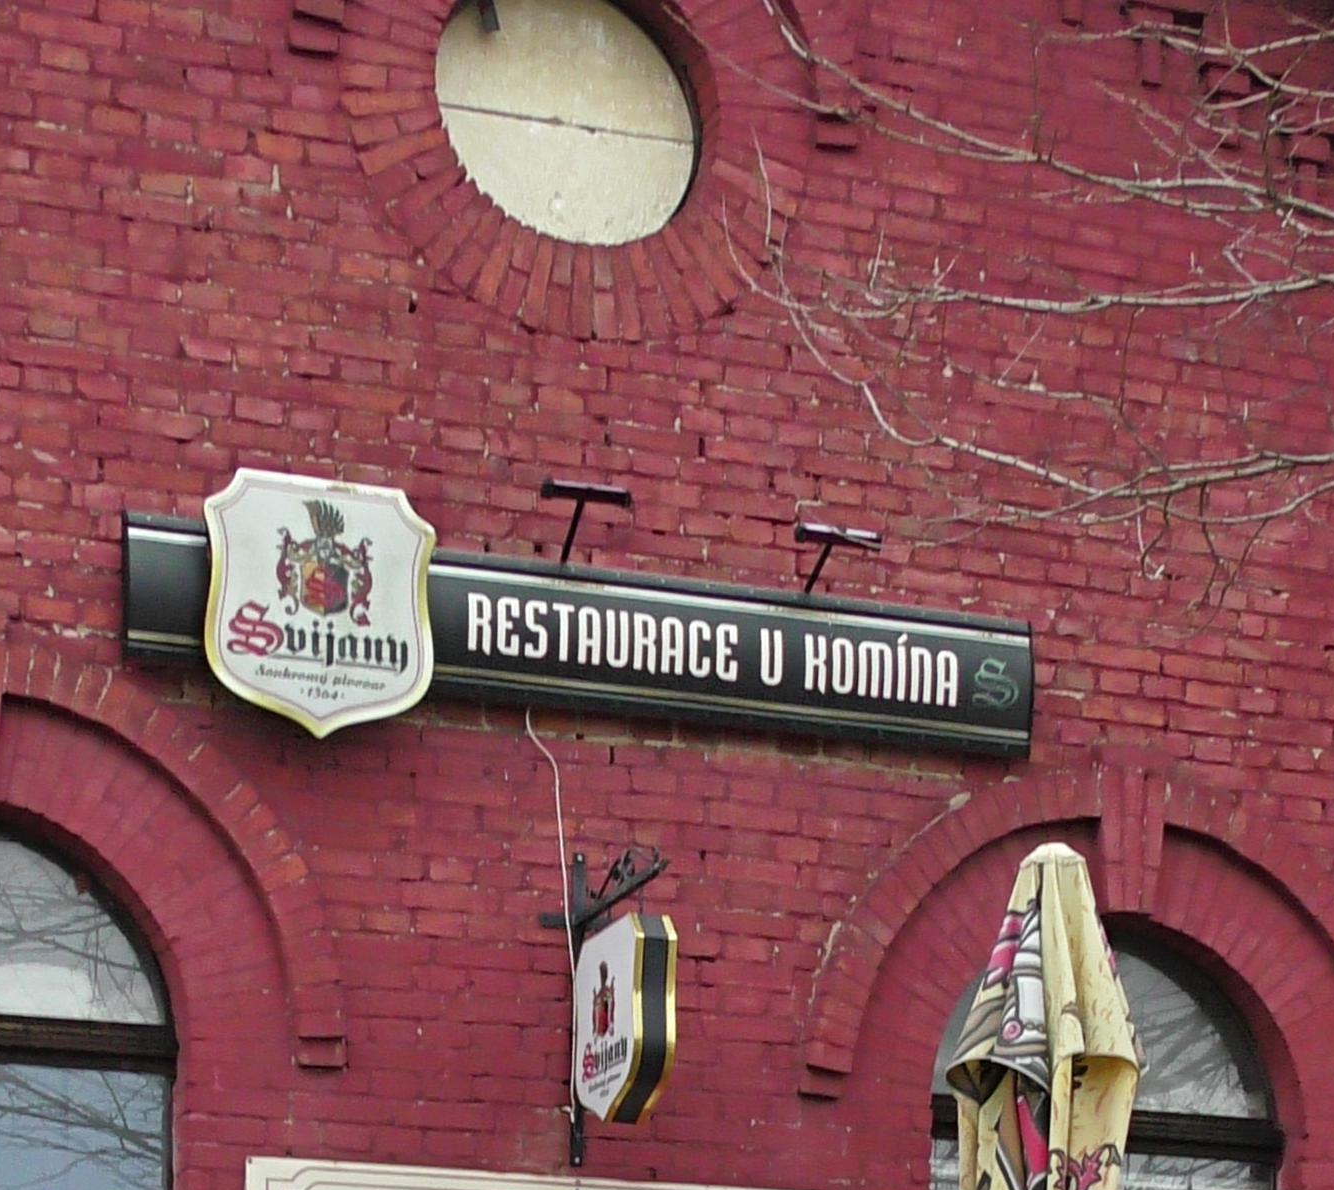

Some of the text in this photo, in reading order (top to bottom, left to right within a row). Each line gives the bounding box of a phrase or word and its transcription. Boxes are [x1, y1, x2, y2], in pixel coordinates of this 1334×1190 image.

[227, 600, 408, 674] Svijany
[467, 592, 738, 682] RESTAURACE
[759, 627, 783, 687] U
[582, 1035, 628, 1082] Svijany
